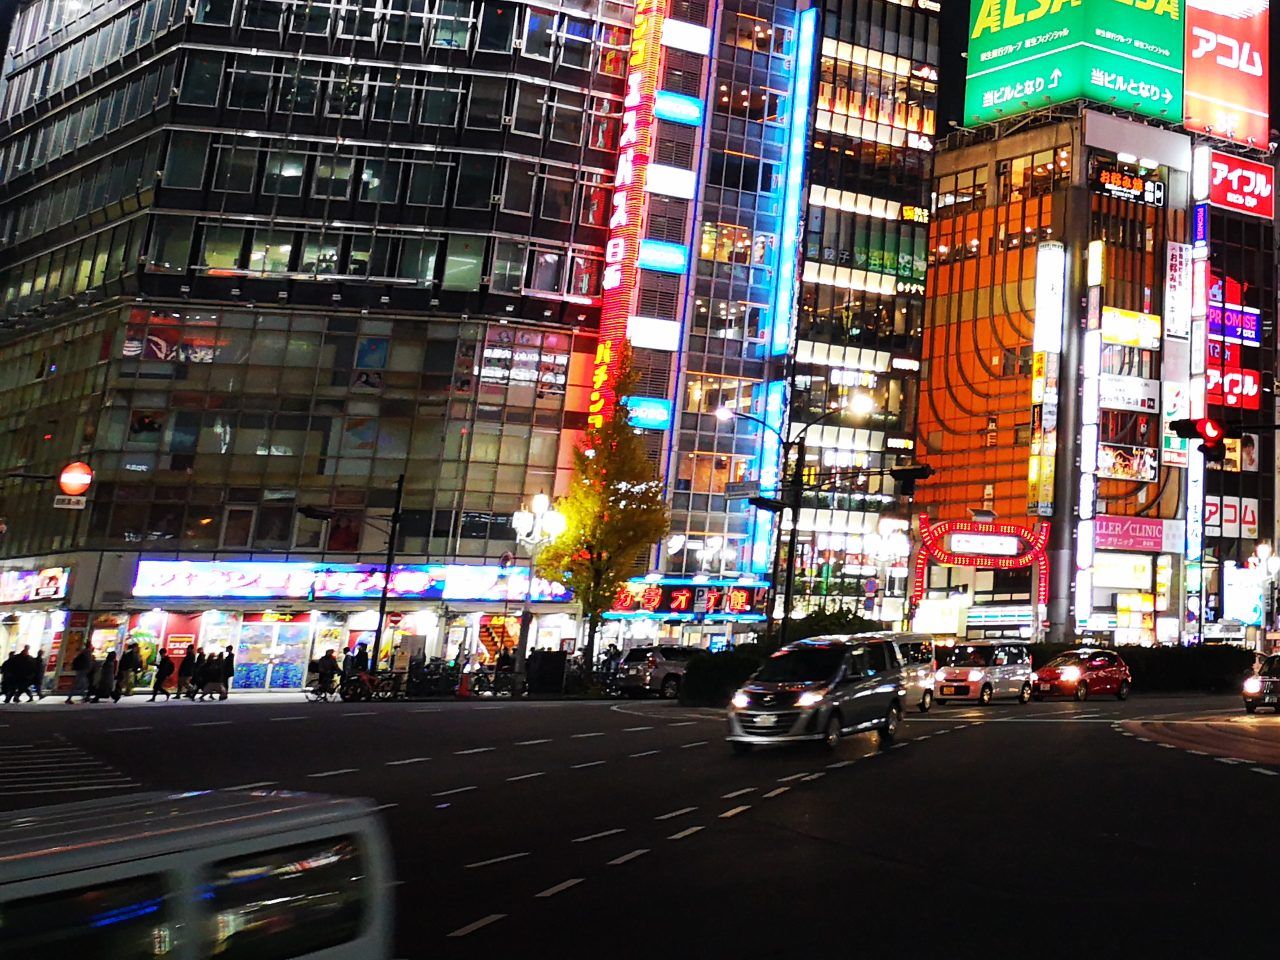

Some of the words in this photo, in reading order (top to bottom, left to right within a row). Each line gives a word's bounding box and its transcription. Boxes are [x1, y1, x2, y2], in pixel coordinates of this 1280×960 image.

[1191, 25, 1263, 77] アコム
[982, 76, 1045, 107] 当ビルとなり
[1091, 68, 1161, 100] 当ビルとなり
[610, 73, 642, 229] エスパス
[1211, 161, 1272, 197] アイフル
[1208, 313, 1257, 329] PROMISE
[588, 340, 612, 428] パチンコ
[1207, 369, 1258, 397] アイフル
[1205, 503, 1257, 526] アコム
